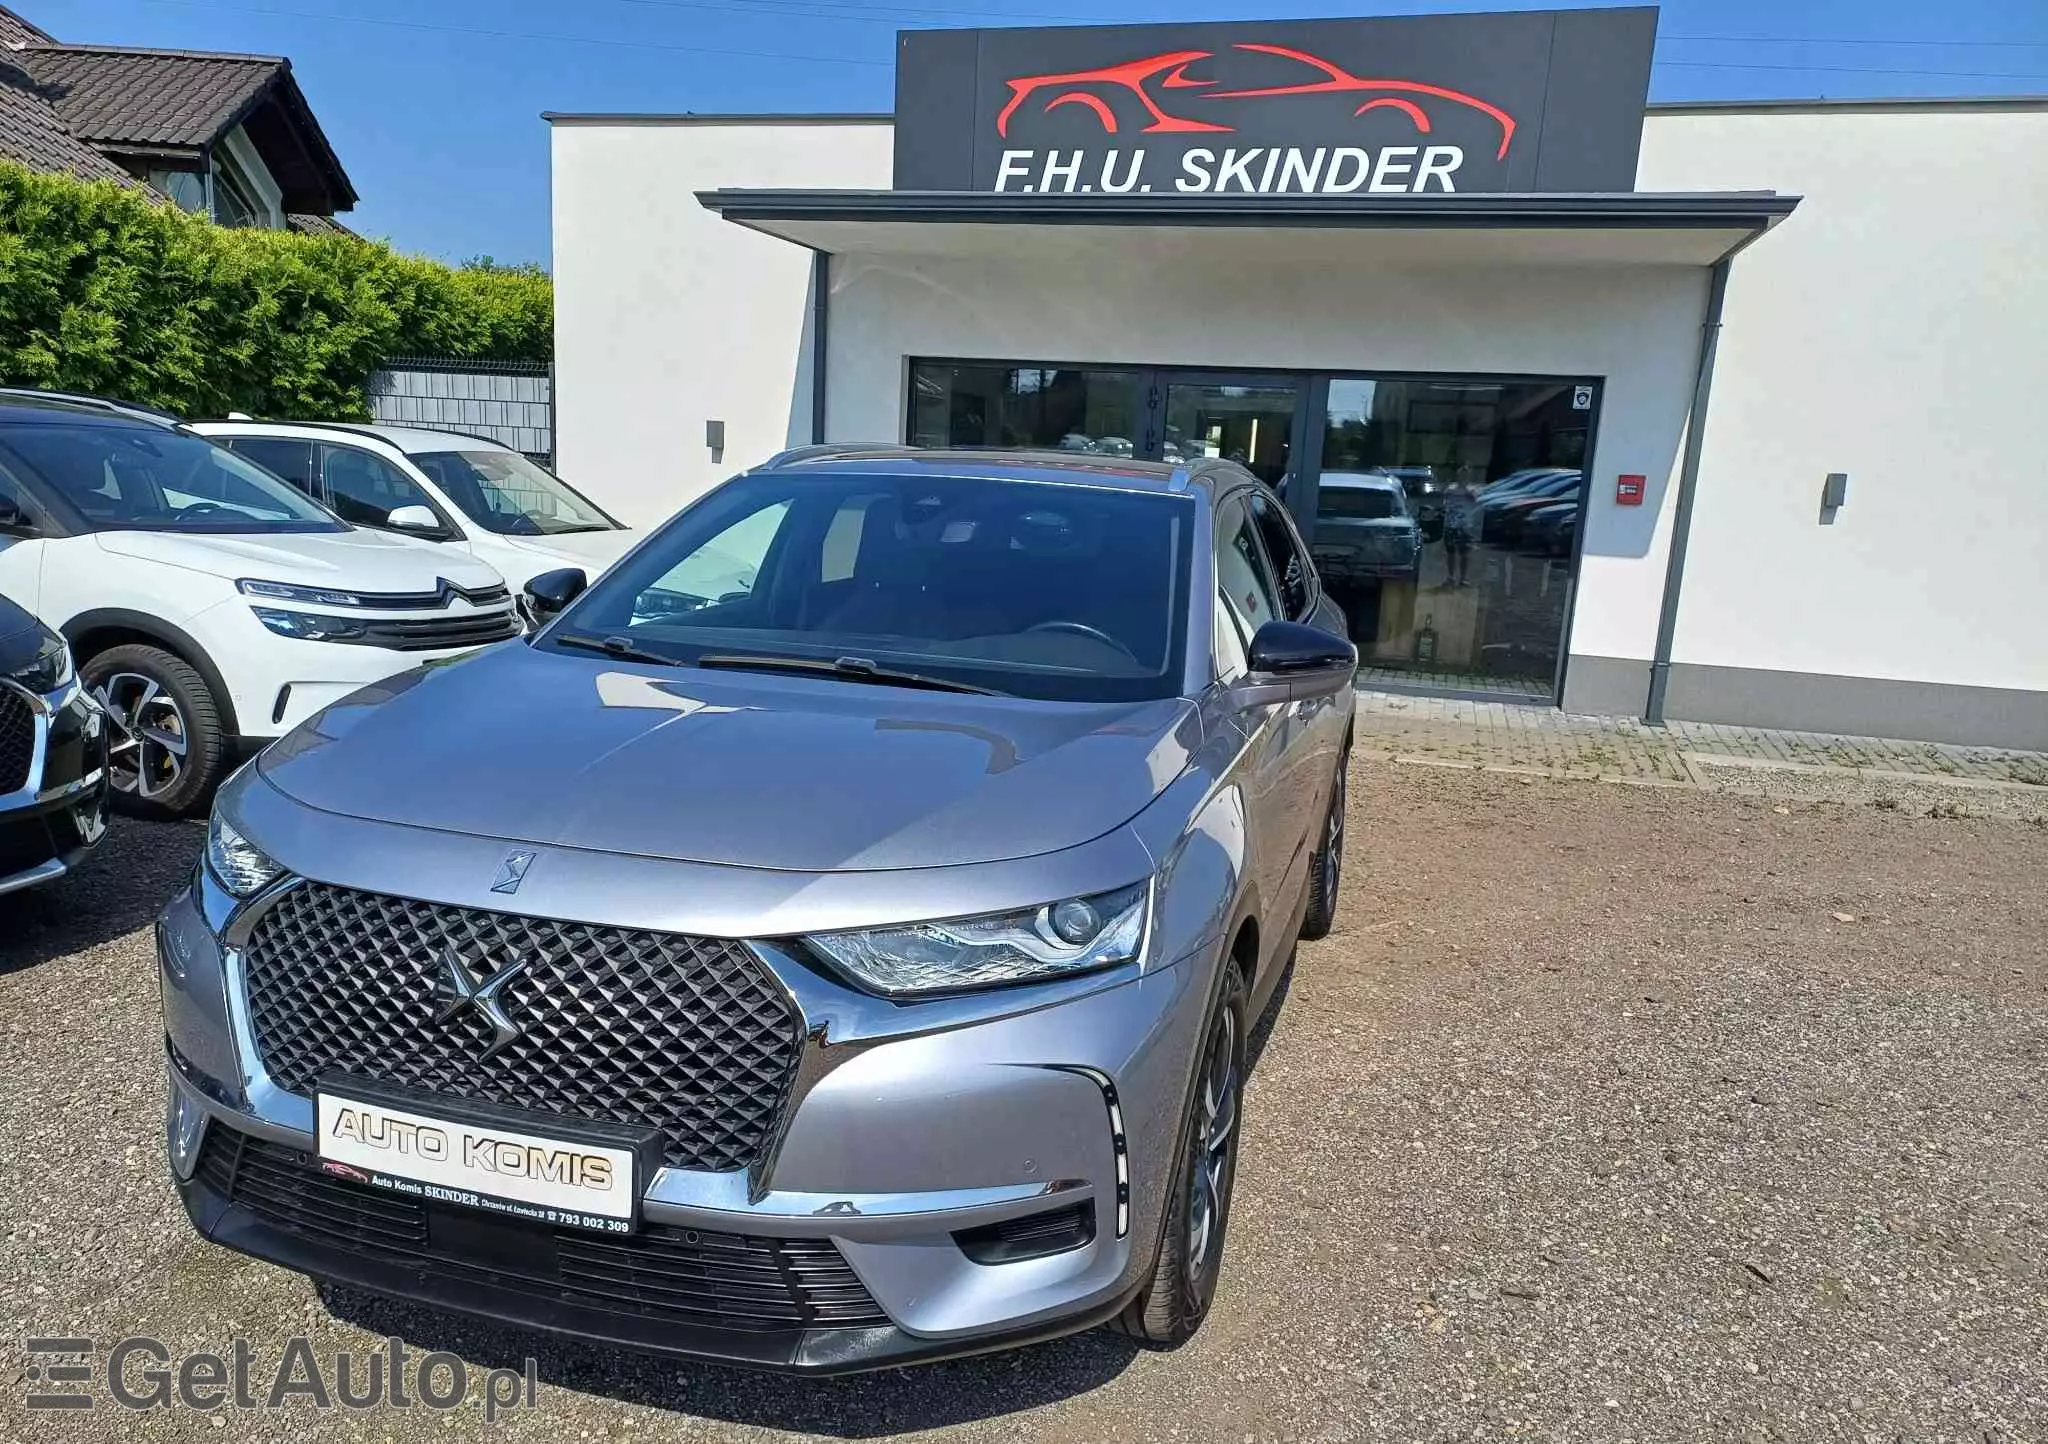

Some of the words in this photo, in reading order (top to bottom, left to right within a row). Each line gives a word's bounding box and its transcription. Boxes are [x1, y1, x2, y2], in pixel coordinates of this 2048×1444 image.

[994, 149, 1151, 192] F.H.U.
[1175, 145, 1464, 193] SKINDER
[333, 1107, 448, 1161] AUTO
[463, 1134, 613, 1190] KOMIS
[372, 1175, 392, 1188] Auto
[394, 1179, 422, 1194] Komis
[424, 1185, 480, 1206] SKINDER
[559, 1212, 580, 1225] 793
[583, 1217, 604, 1229] 002
[607, 1220, 629, 1233] 309
